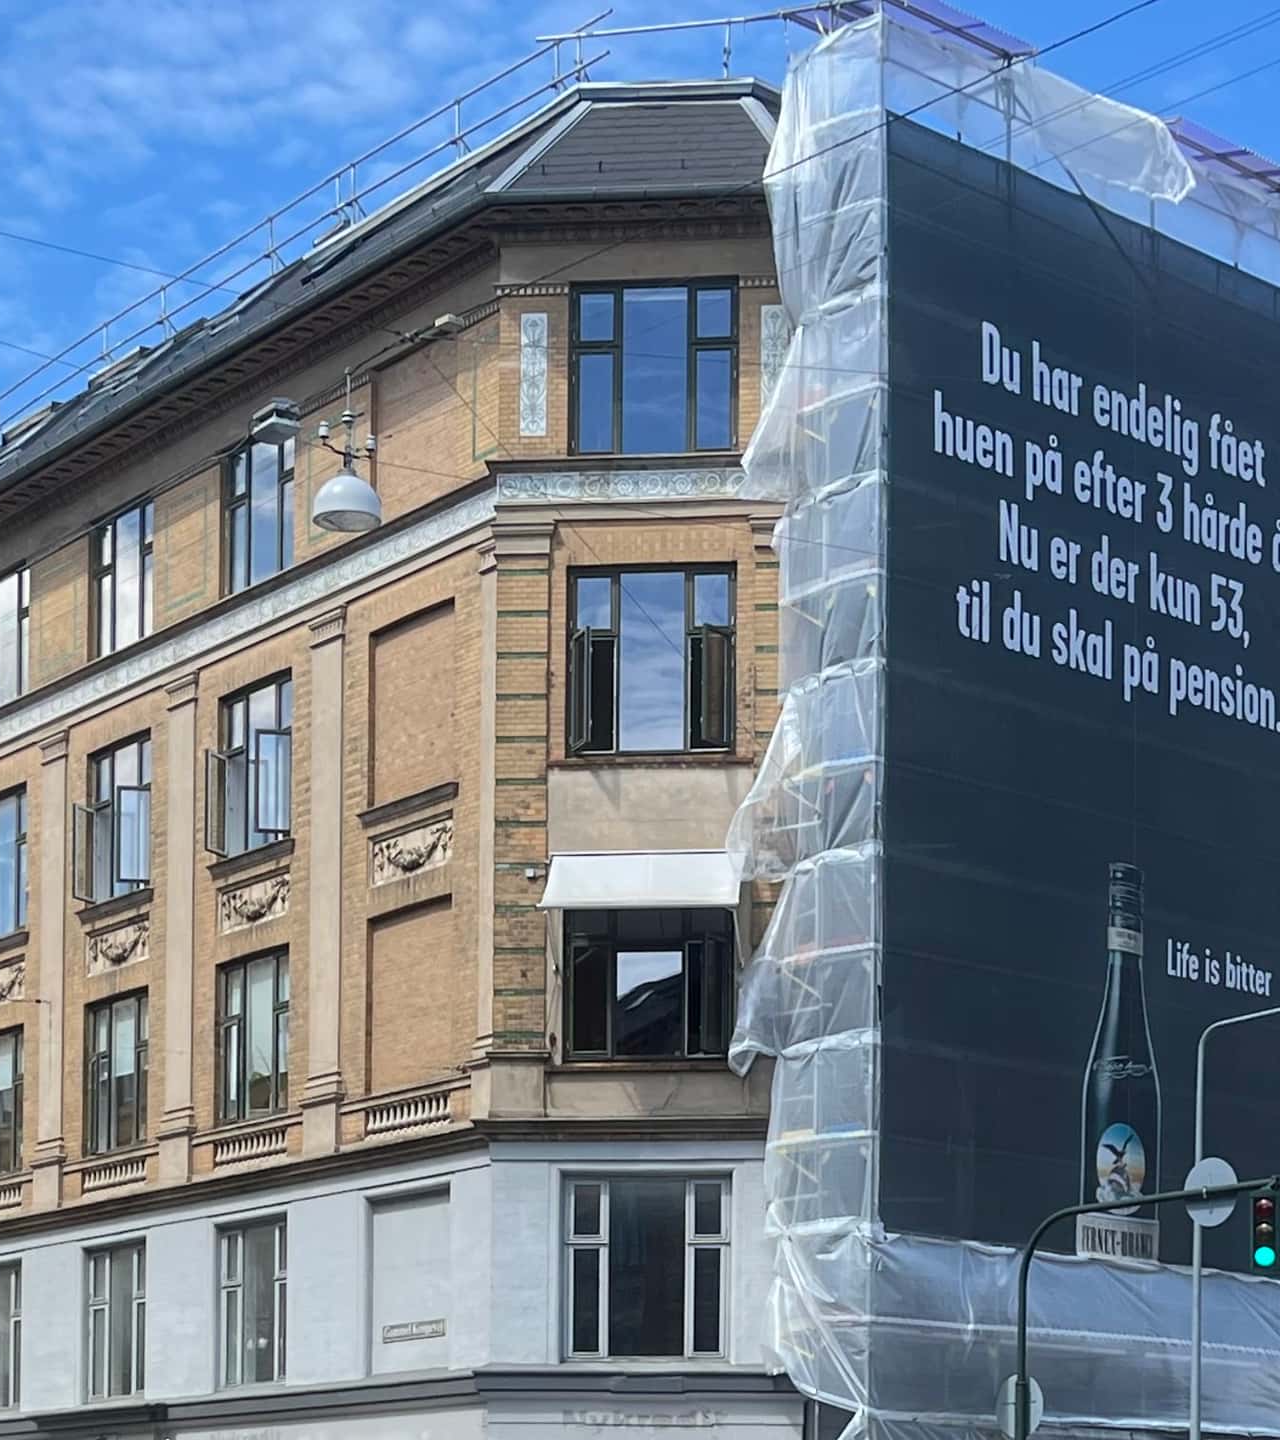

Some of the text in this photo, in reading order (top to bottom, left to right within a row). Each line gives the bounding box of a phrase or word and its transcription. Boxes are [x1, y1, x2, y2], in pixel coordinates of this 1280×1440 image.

[933, 389, 1014, 477] huen
[1025, 434, 1063, 501] på
[1074, 449, 1147, 524] efter
[1156, 472, 1173, 533] 3
[1183, 482, 1263, 565] hårde
[981, 320, 1266, 488] Du har endelig fået
[956, 578, 990, 644] til
[1002, 590, 1041, 659] du
[1052, 608, 1112, 681] skal
[1123, 636, 1159, 702] på
[999, 499, 1251, 649] Nu er der kun 53,
[1167, 938, 1273, 997] Life is bitter
